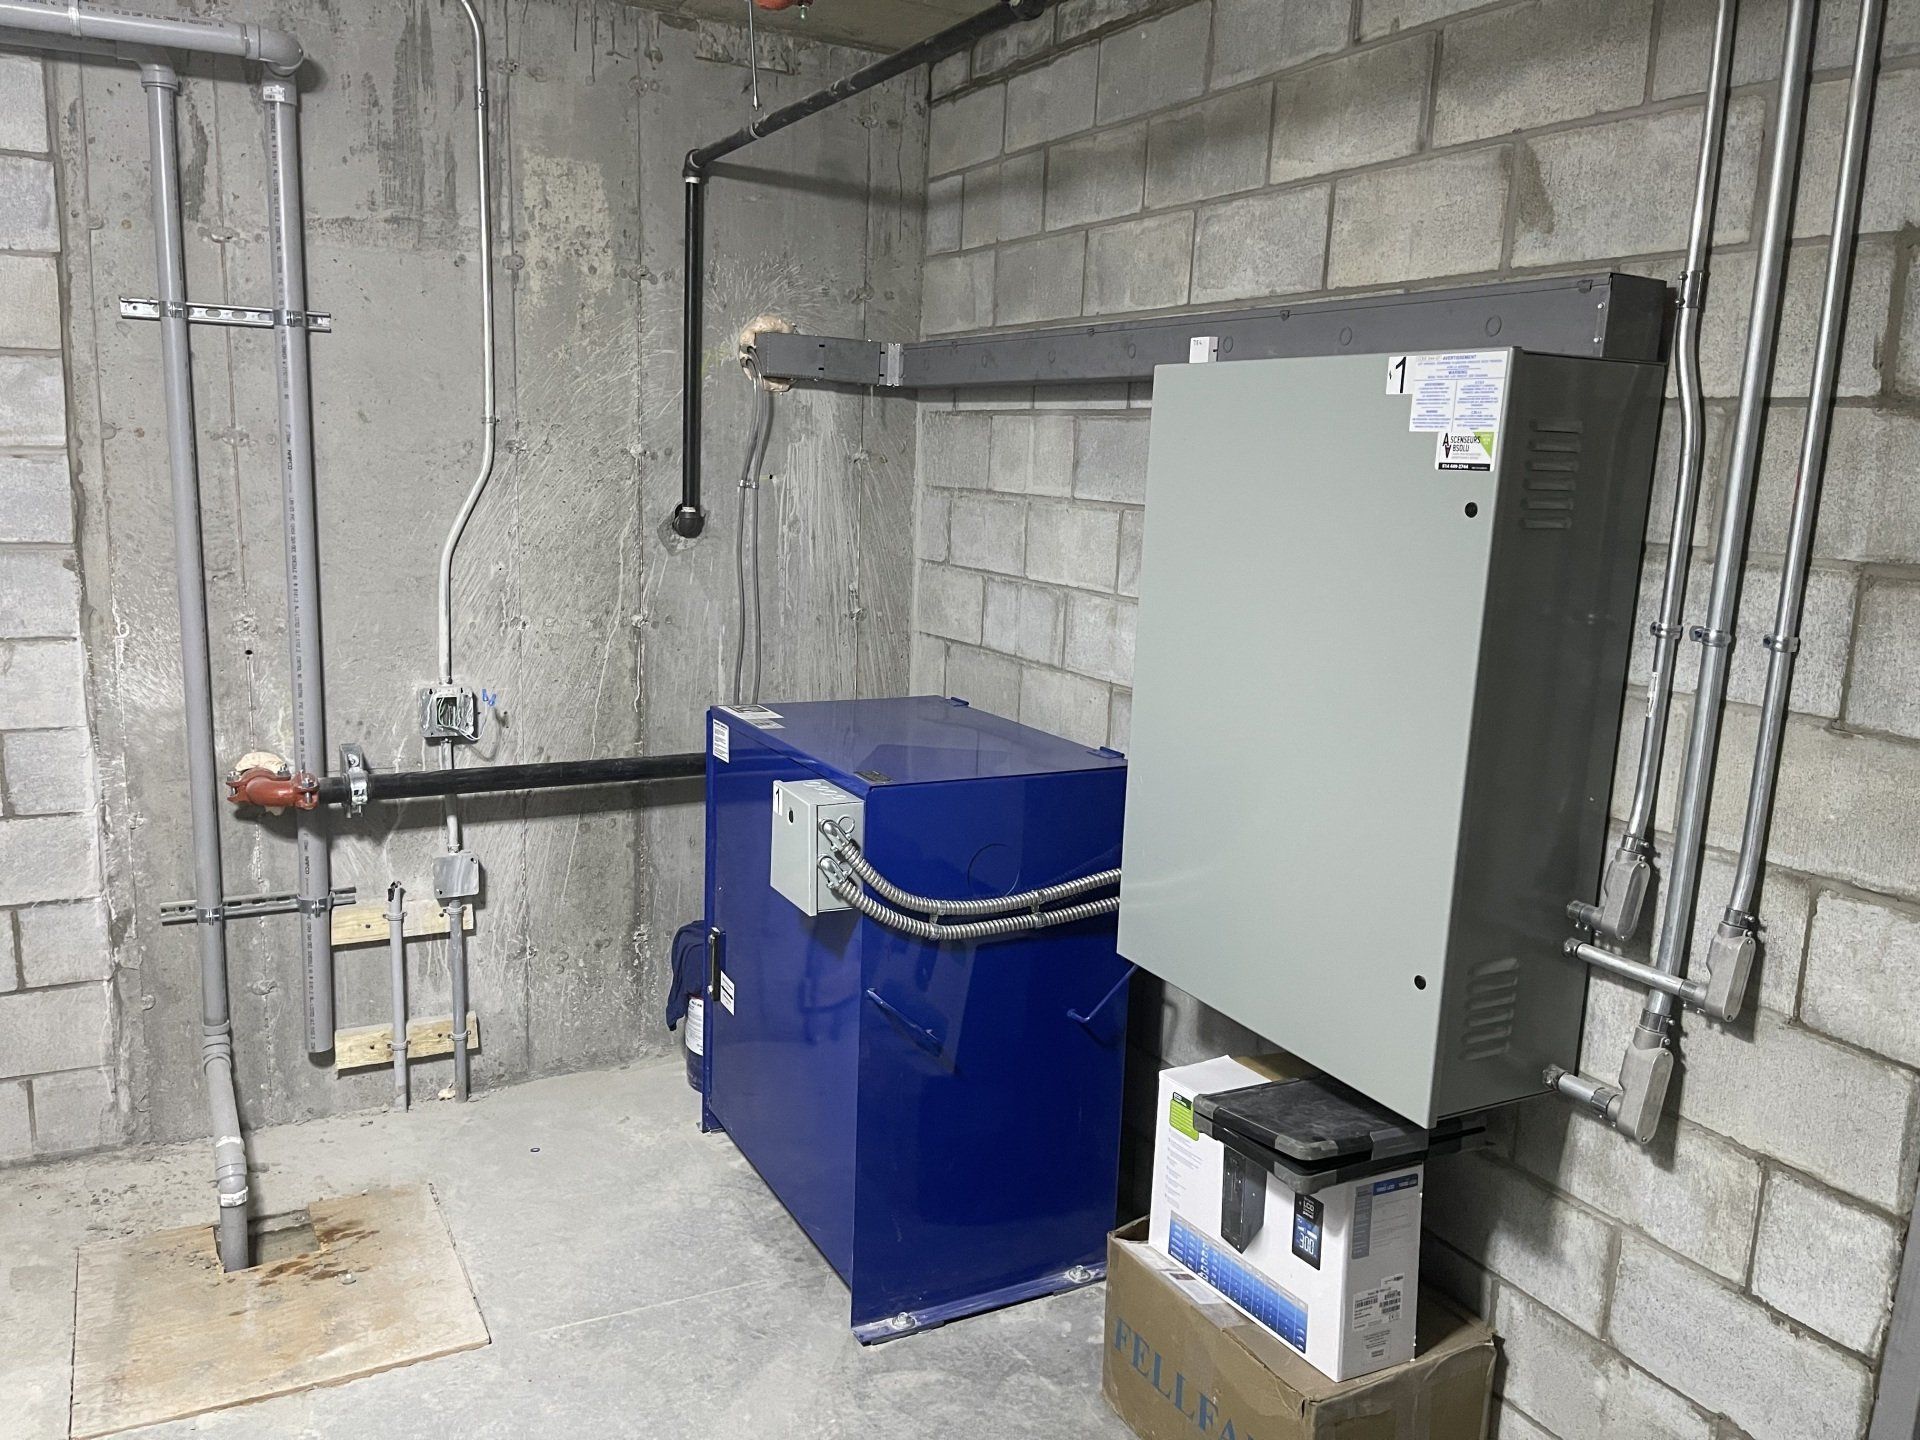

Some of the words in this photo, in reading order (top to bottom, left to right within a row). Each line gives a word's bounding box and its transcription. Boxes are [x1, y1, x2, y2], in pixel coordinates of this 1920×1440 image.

[1395, 356, 1407, 394] 1
[775, 787, 780, 814] 1
[1303, 1200, 1315, 1211] LCD
[1299, 1233, 1315, 1255] 300
[1113, 1317, 1263, 1440] FELLFA
